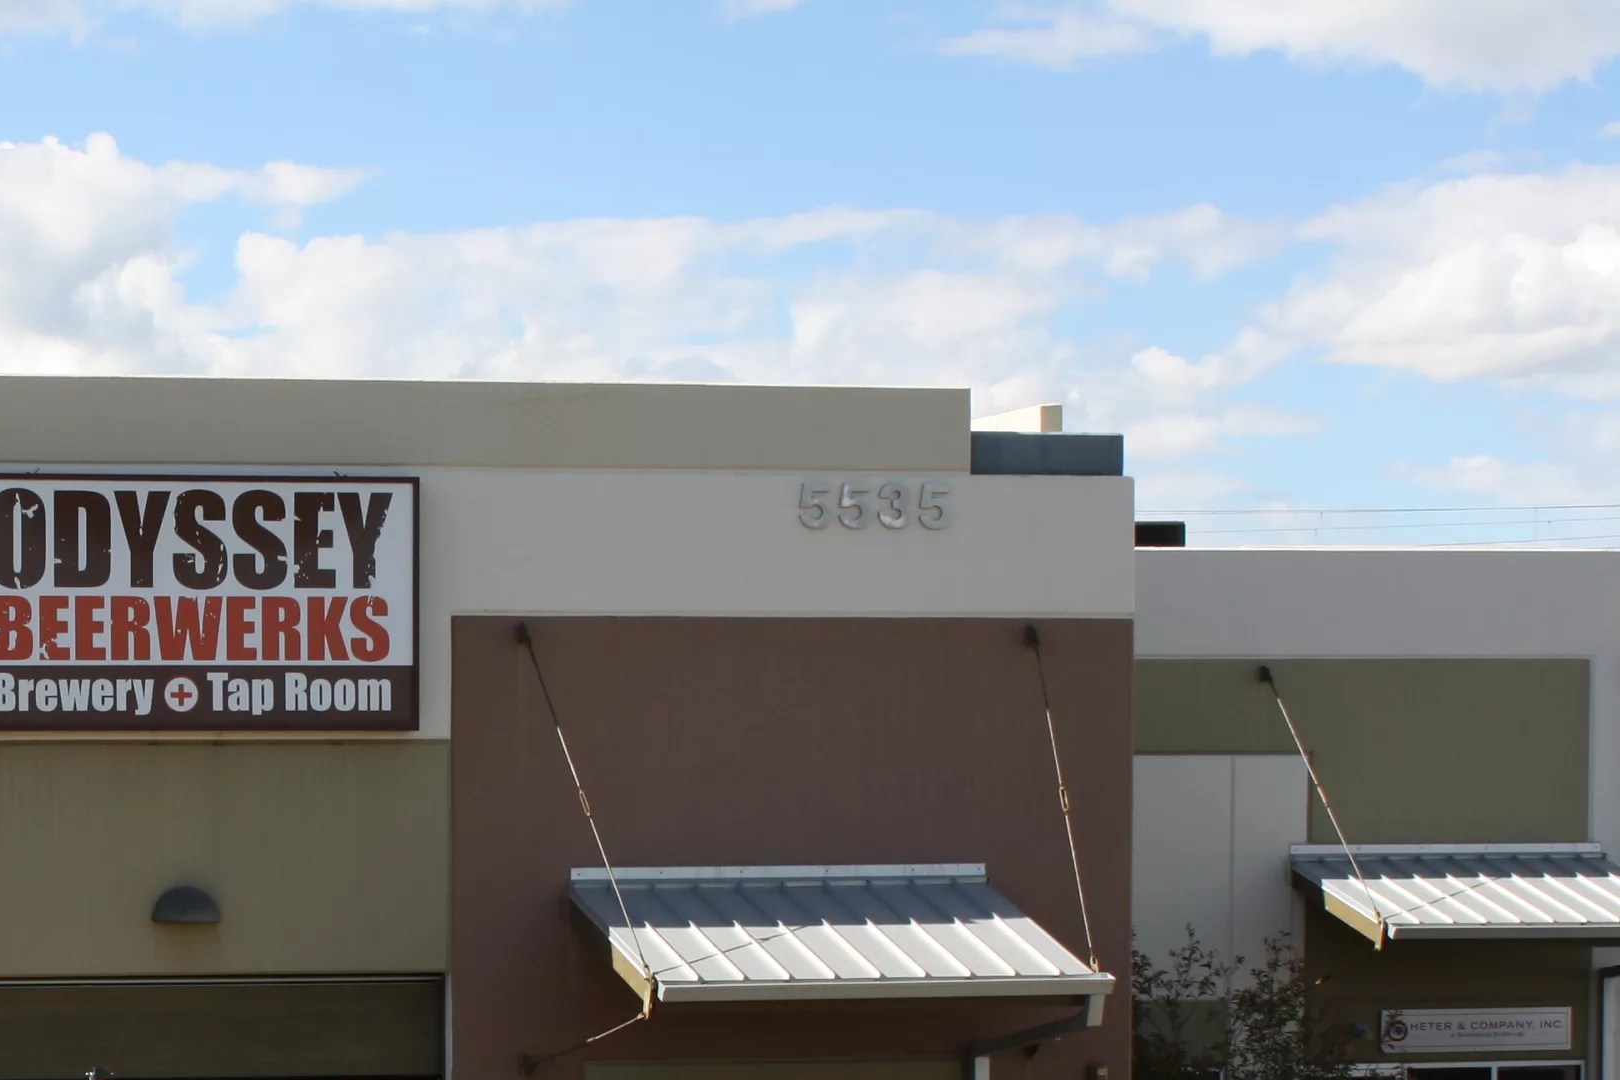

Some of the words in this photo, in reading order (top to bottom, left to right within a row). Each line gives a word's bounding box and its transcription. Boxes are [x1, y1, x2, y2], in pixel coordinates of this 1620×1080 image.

[798, 482, 952, 530] 5535
[207, 672, 274, 715] Tap
[285, 672, 392, 712] Room
